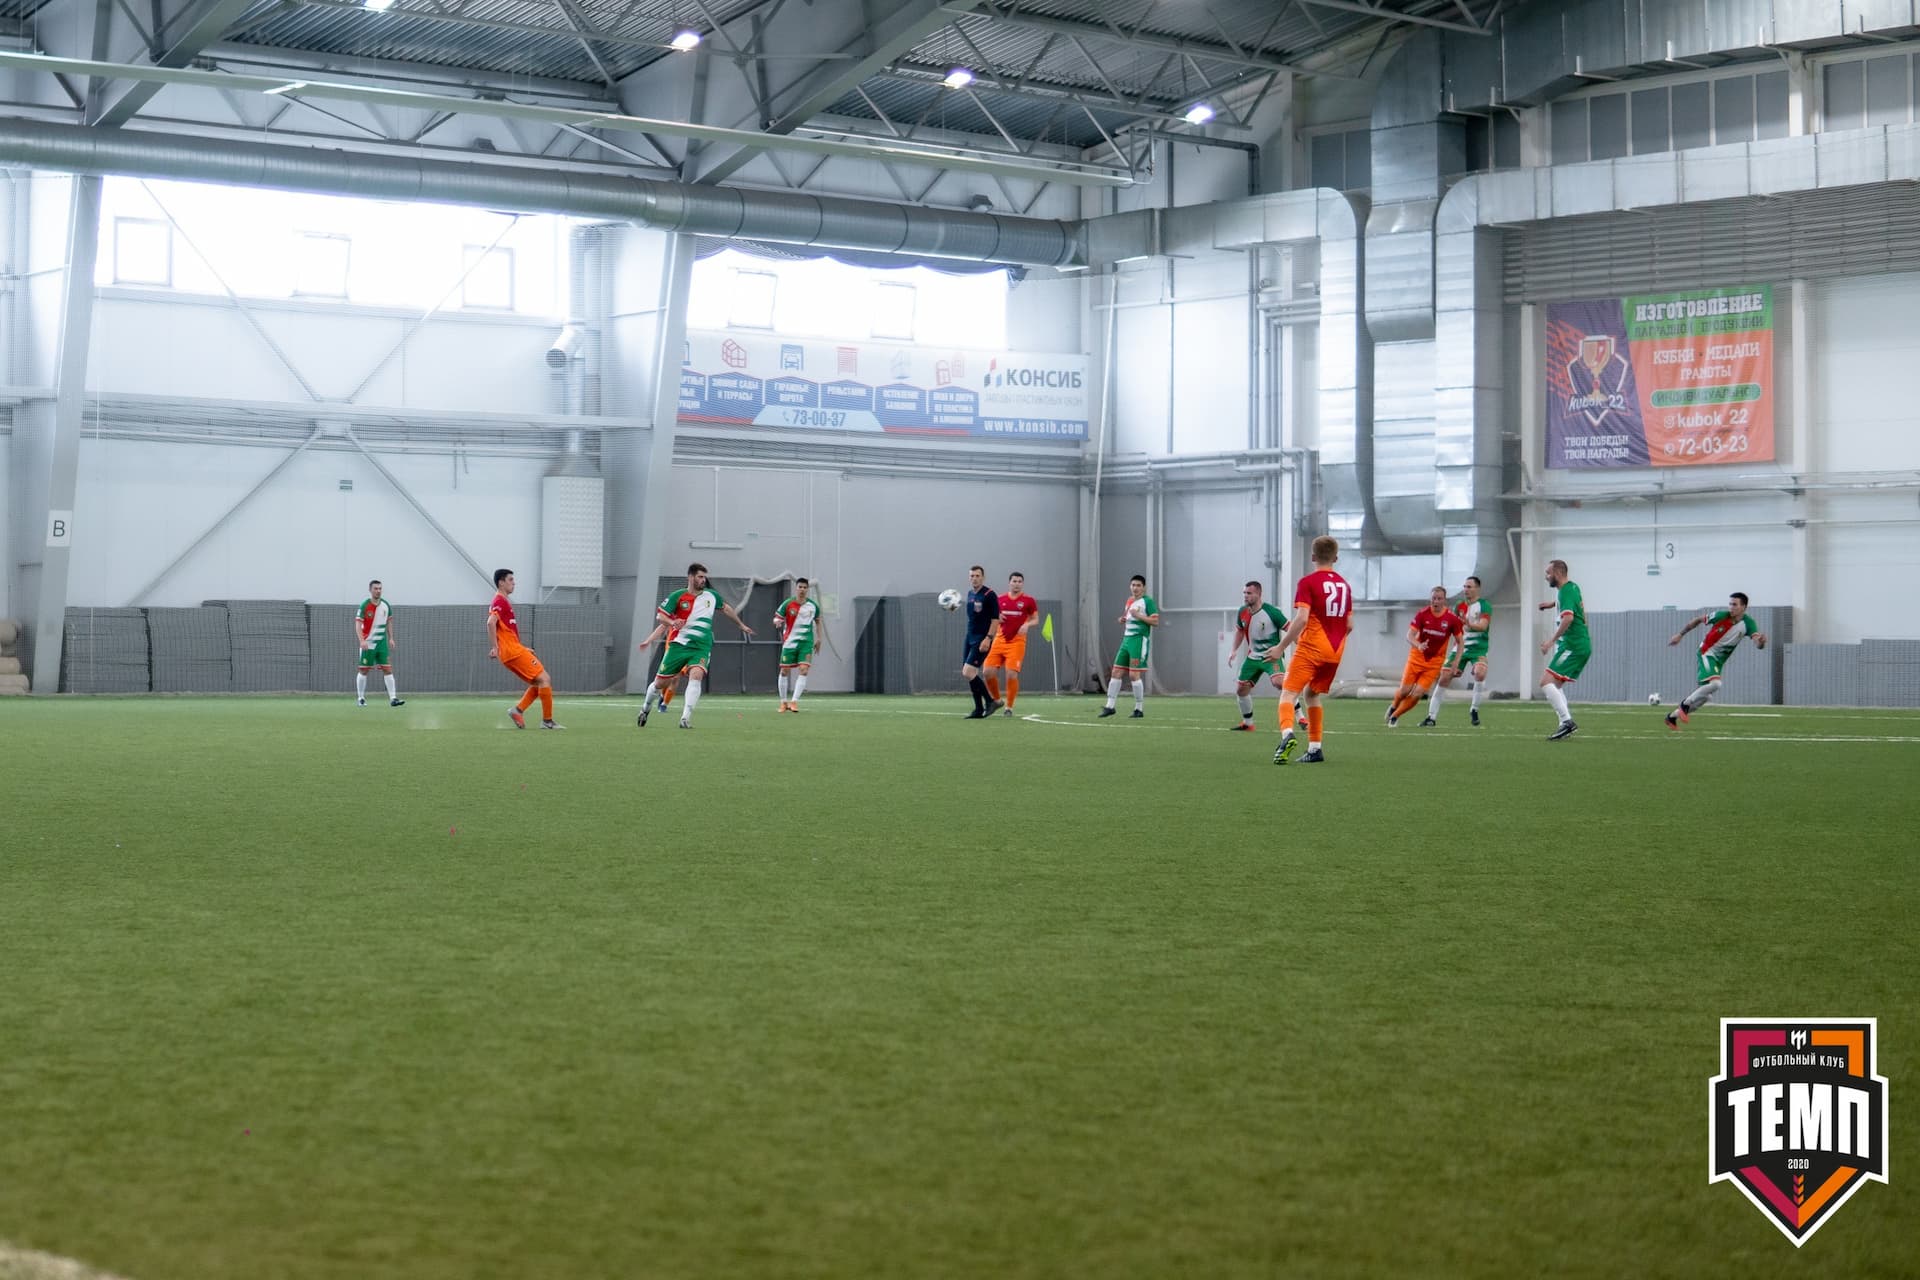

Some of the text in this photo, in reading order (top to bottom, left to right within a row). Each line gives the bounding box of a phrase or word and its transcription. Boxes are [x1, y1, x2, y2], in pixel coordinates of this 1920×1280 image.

[1635, 293, 1763, 322] ИЗГОТОВЛЕНИЕ
[1653, 342, 1760, 364] КУБКИ МЕДАЛИ
[1006, 368, 1082, 388] КОНСИБ
[1680, 365, 1732, 381] ГРАМОТЫ
[792, 410, 846, 427] 73-00-37
[983, 419, 1084, 435] www.konsib.com
[1678, 408, 1748, 428] kubok_22
[1678, 435, 1748, 455] 72-03-23
[1665, 542, 1674, 560] 3
[1322, 581, 1347, 617] 27
